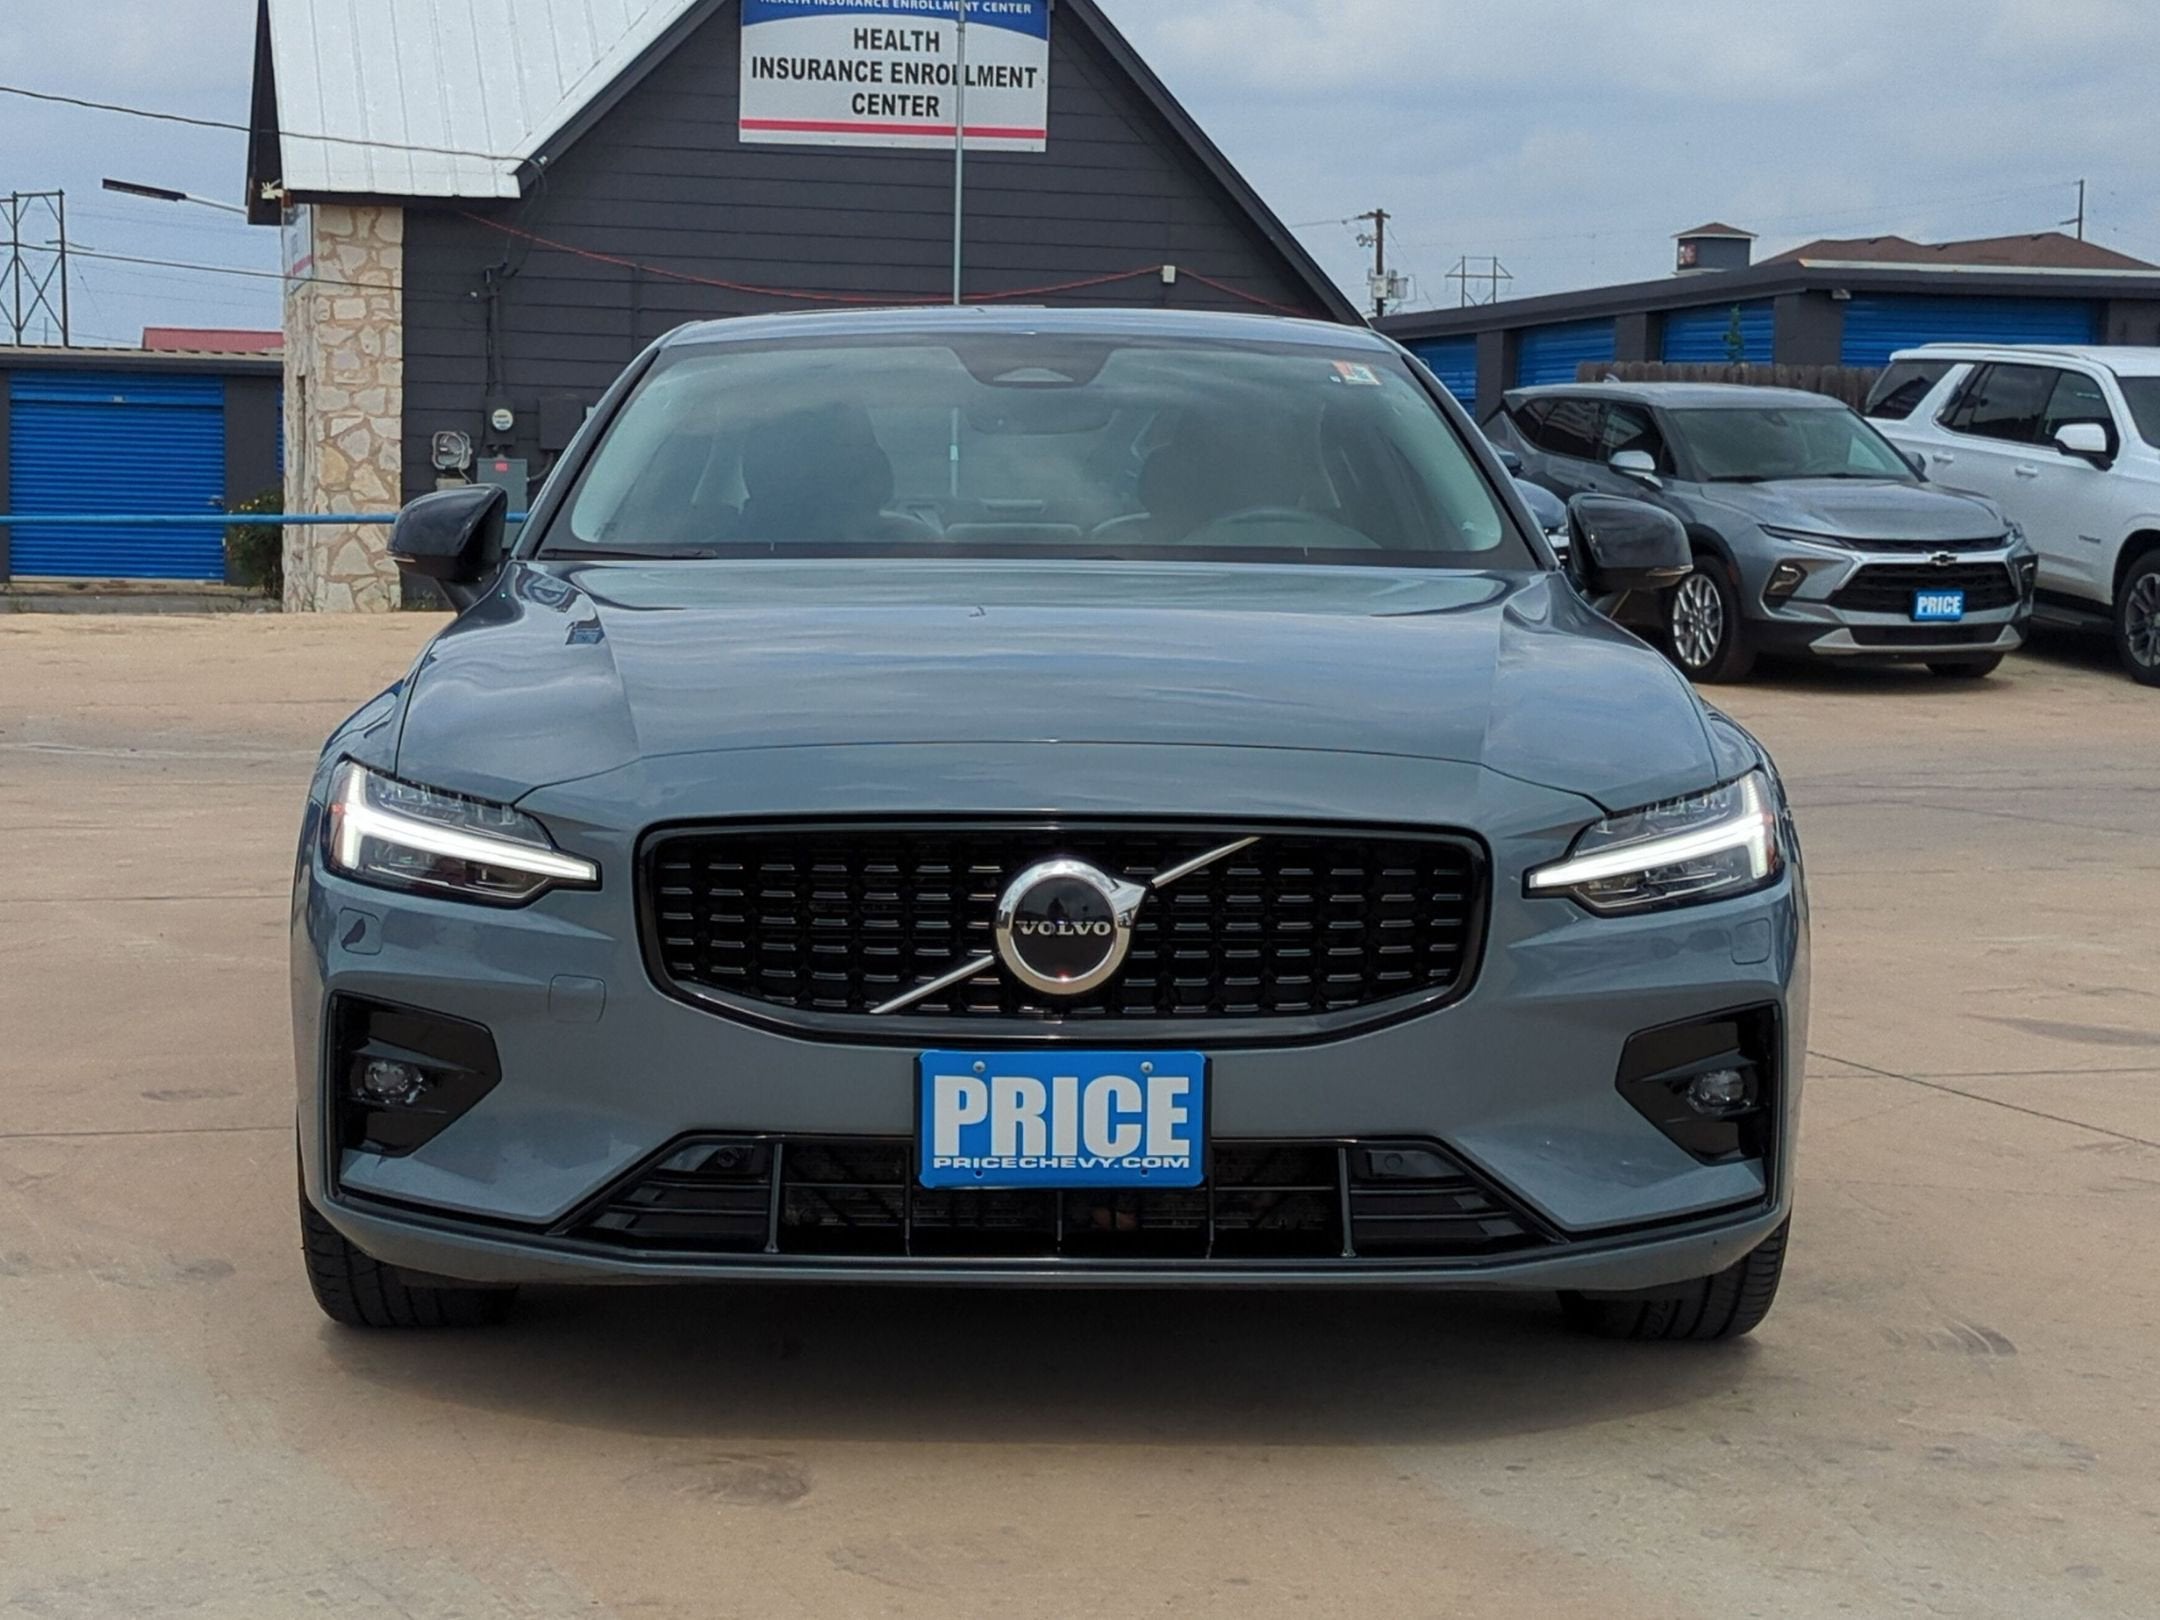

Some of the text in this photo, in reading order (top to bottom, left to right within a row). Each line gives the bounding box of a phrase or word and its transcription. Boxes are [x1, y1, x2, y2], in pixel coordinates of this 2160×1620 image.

[892, 0, 979, 12] ENROLLMENT
[982, 2, 1032, 14] CENTER
[853, 28, 940, 52] HEALTH
[752, 56, 1037, 88] INSURANCE ENROLLMENT
[852, 93, 940, 117] CENTER
[1917, 596, 1961, 613] PRICE
[1015, 920, 1111, 936] VOLVO
[934, 1075, 1190, 1157] PRICE
[934, 1157, 1190, 1169] PRICECHEVY.COM
